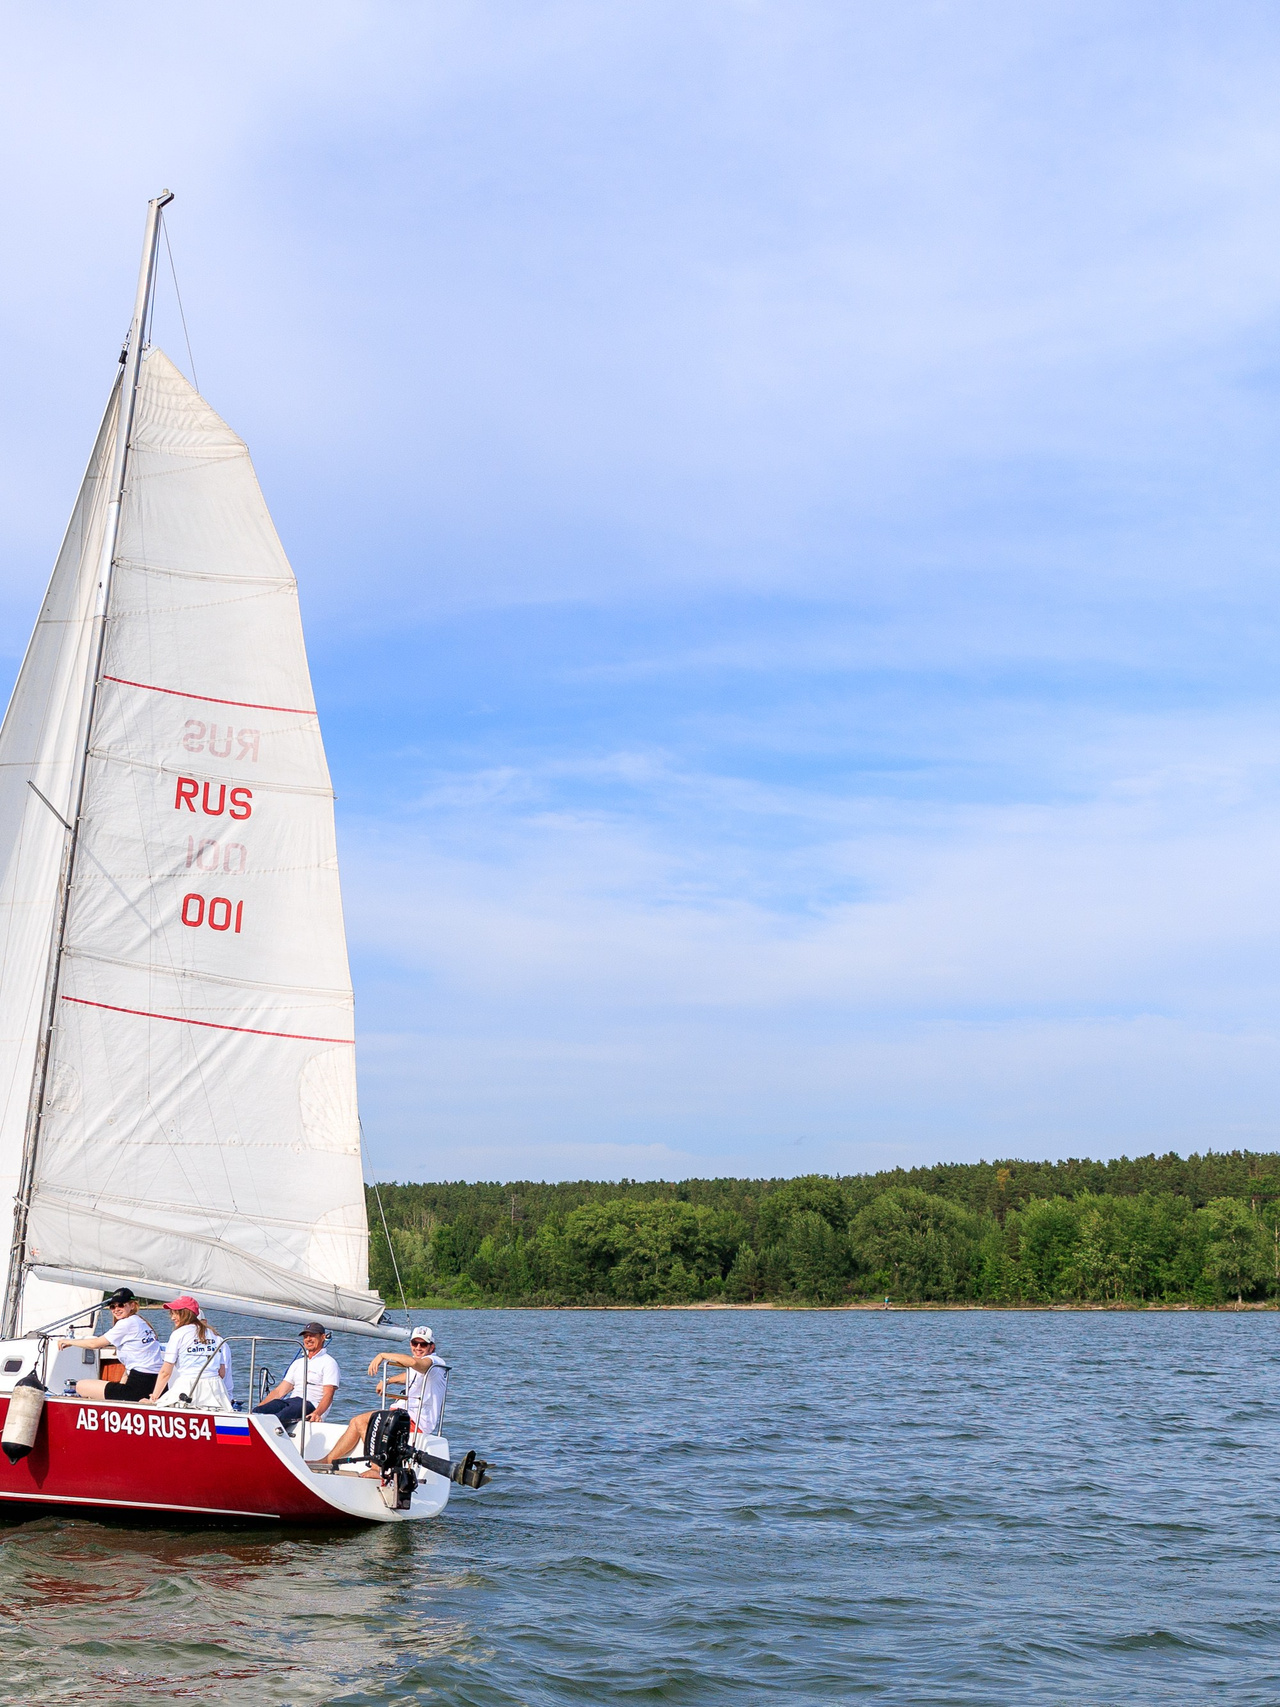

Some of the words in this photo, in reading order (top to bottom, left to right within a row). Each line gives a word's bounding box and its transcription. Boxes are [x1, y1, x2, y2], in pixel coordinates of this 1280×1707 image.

[174, 776, 253, 820] RUS
[181, 893, 244, 933] 001
[76, 1408, 99, 1431] AB
[100, 1410, 145, 1436] 1949
[148, 1414, 187, 1439] RUS
[189, 1418, 212, 1441] 54
[369, 1412, 382, 1457] MERCURY
